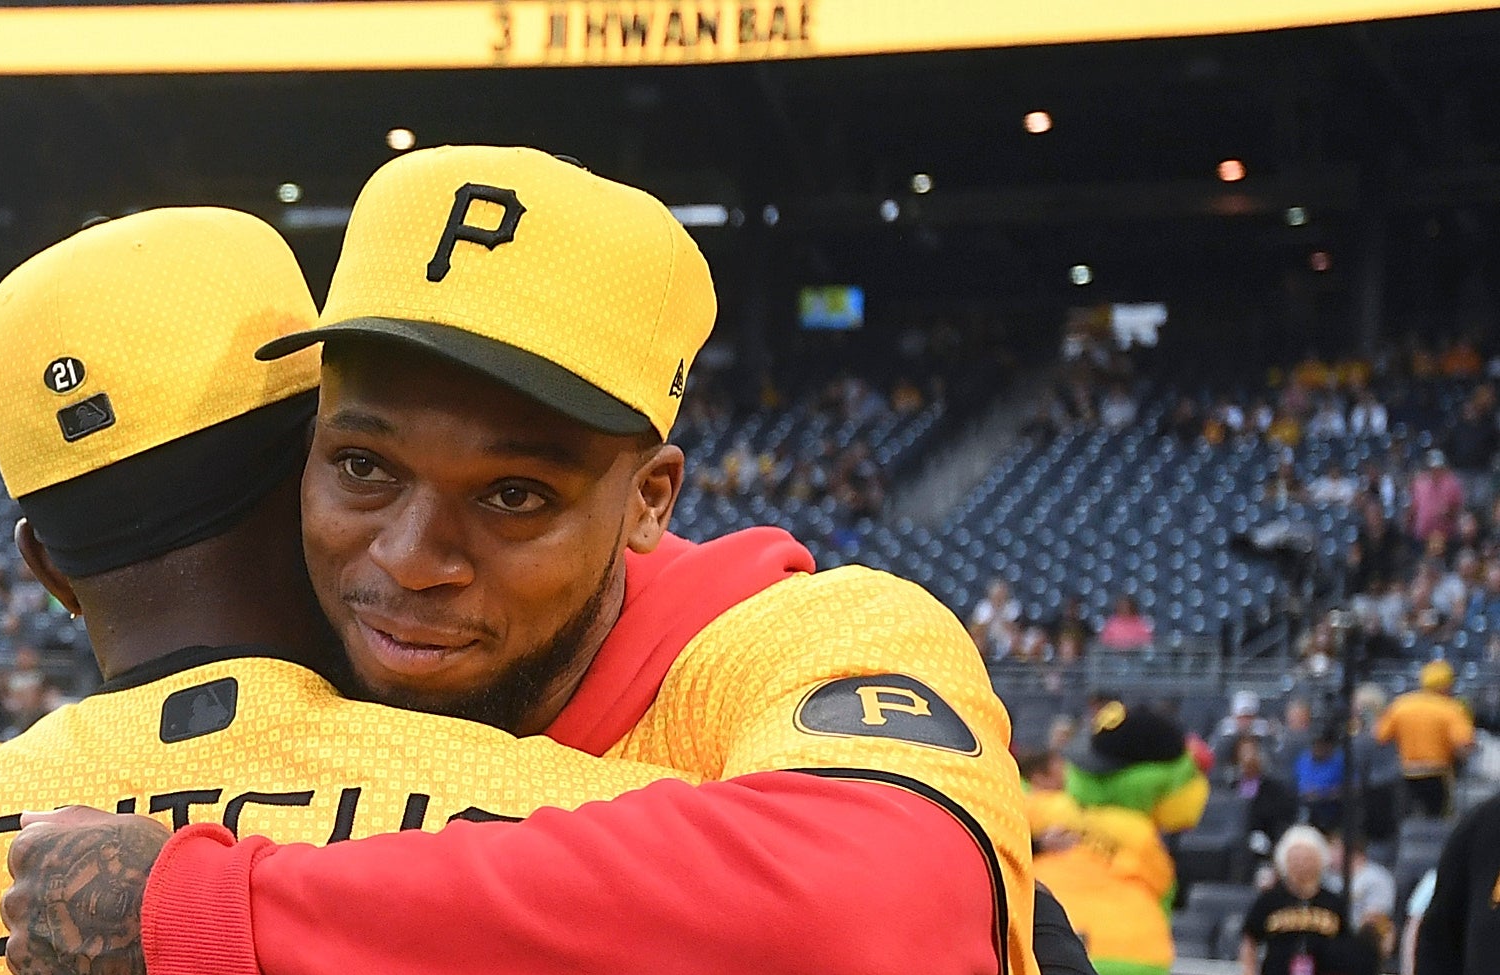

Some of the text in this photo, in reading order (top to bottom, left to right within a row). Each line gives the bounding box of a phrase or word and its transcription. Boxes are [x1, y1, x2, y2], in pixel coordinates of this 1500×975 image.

[585, 8, 718, 49] HWAN
[737, 3, 814, 45] BAE
[425, 181, 528, 283] P
[51, 358, 78, 391] 21
[854, 685, 933, 726] P
